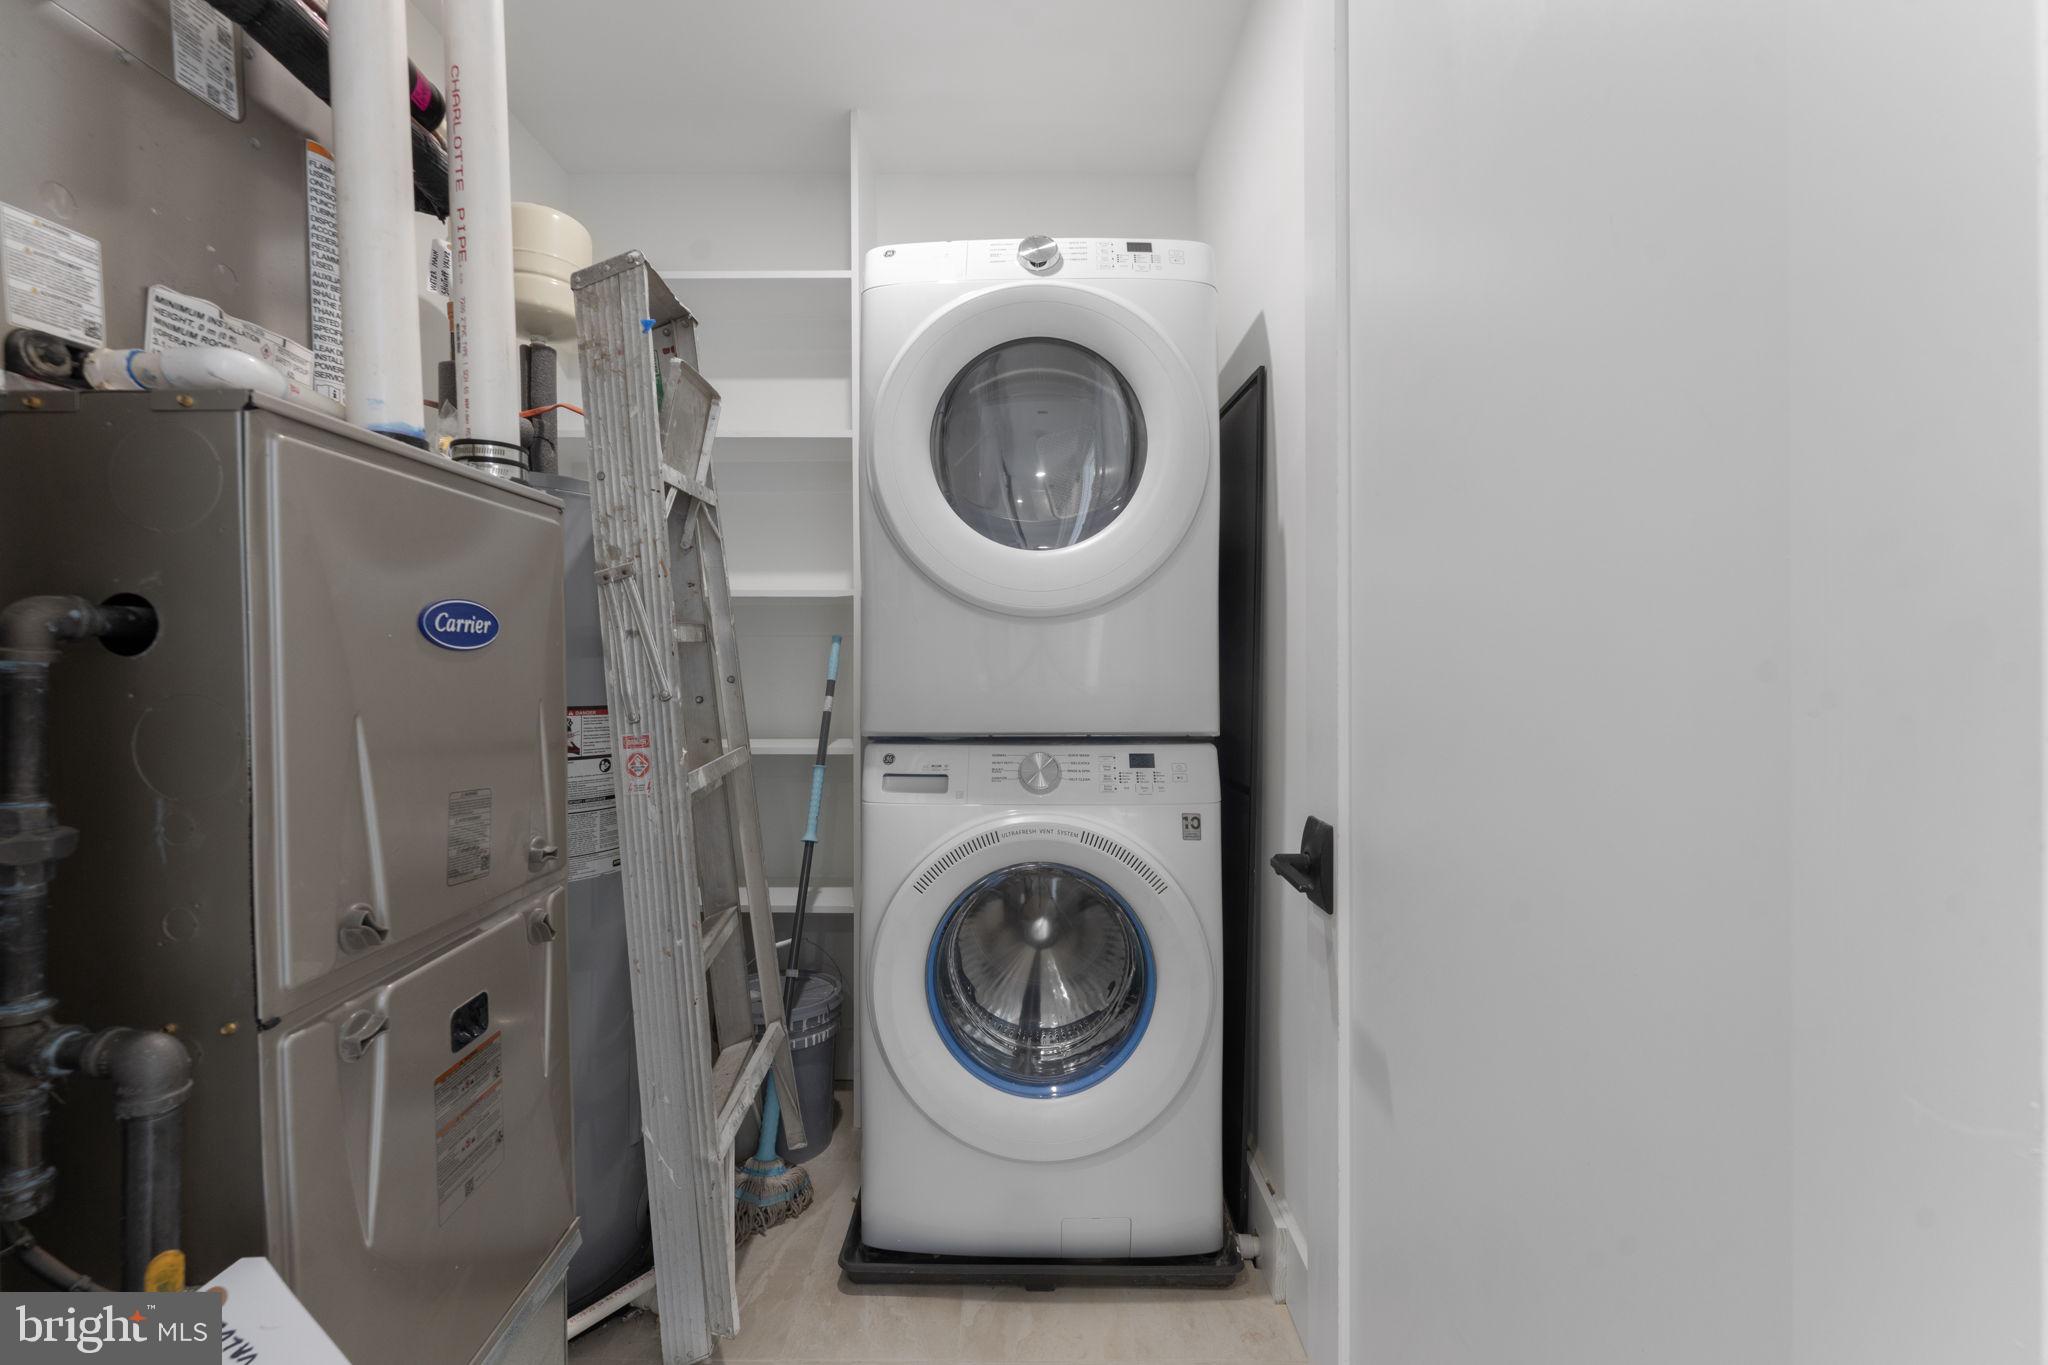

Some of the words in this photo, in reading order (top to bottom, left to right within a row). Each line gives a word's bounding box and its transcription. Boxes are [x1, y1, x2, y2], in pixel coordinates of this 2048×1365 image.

[450, 64, 464, 192] CHARLOTTE
[310, 178, 330, 190] ONLY
[313, 280, 330, 289] MAY
[313, 288, 338, 301] SHALL
[322, 300, 336, 310] THE
[313, 306, 335, 318] THAN
[155, 295, 205, 319] MINIMUM
[207, 316, 260, 344] INSTALLATION
[313, 316, 340, 327] LISTED
[154, 317, 198, 339] MINIMUM
[314, 344, 335, 354] LEAK
[434, 612, 492, 634] Carrier
[1001, 829, 1036, 838] ULTRAFRESH
[1057, 830, 1079, 838] SYSTEM
[222, 1322, 258, 1365] VALV
